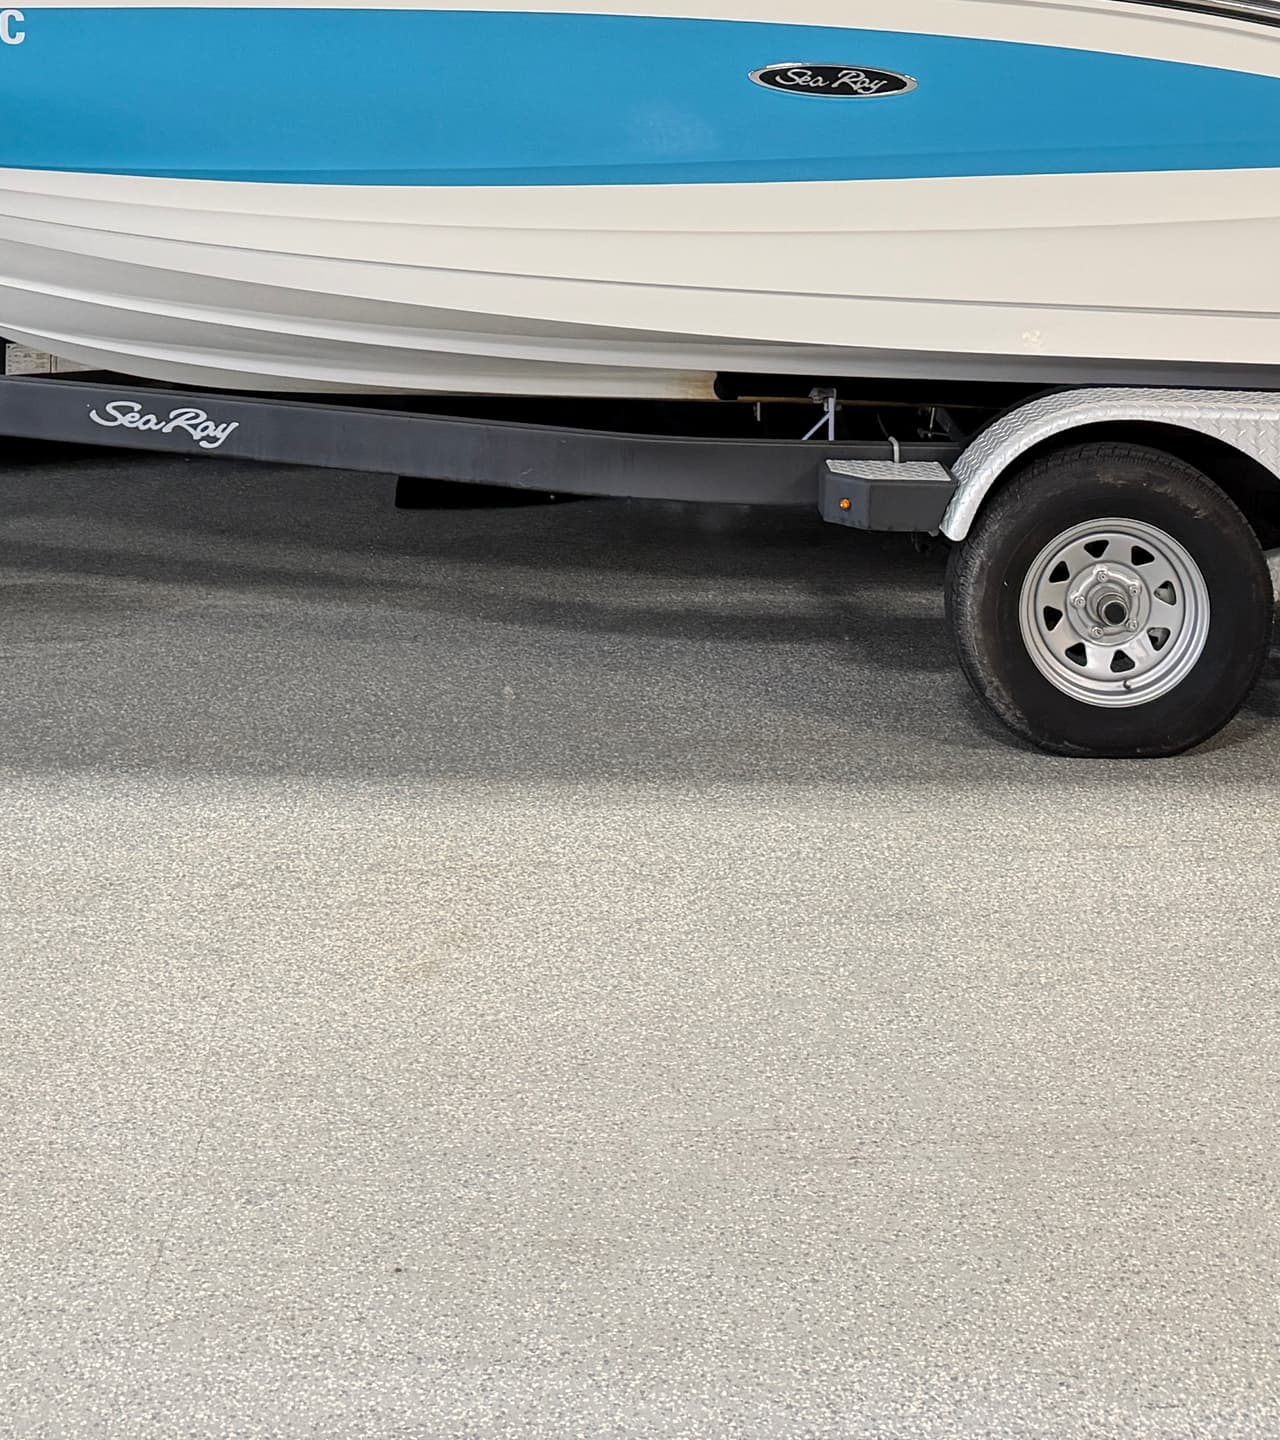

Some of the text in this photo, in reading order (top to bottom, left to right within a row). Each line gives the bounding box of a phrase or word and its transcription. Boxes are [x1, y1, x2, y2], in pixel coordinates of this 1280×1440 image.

[775, 68, 889, 94] Sea Ray
[89, 400, 239, 449] Sea Ray
